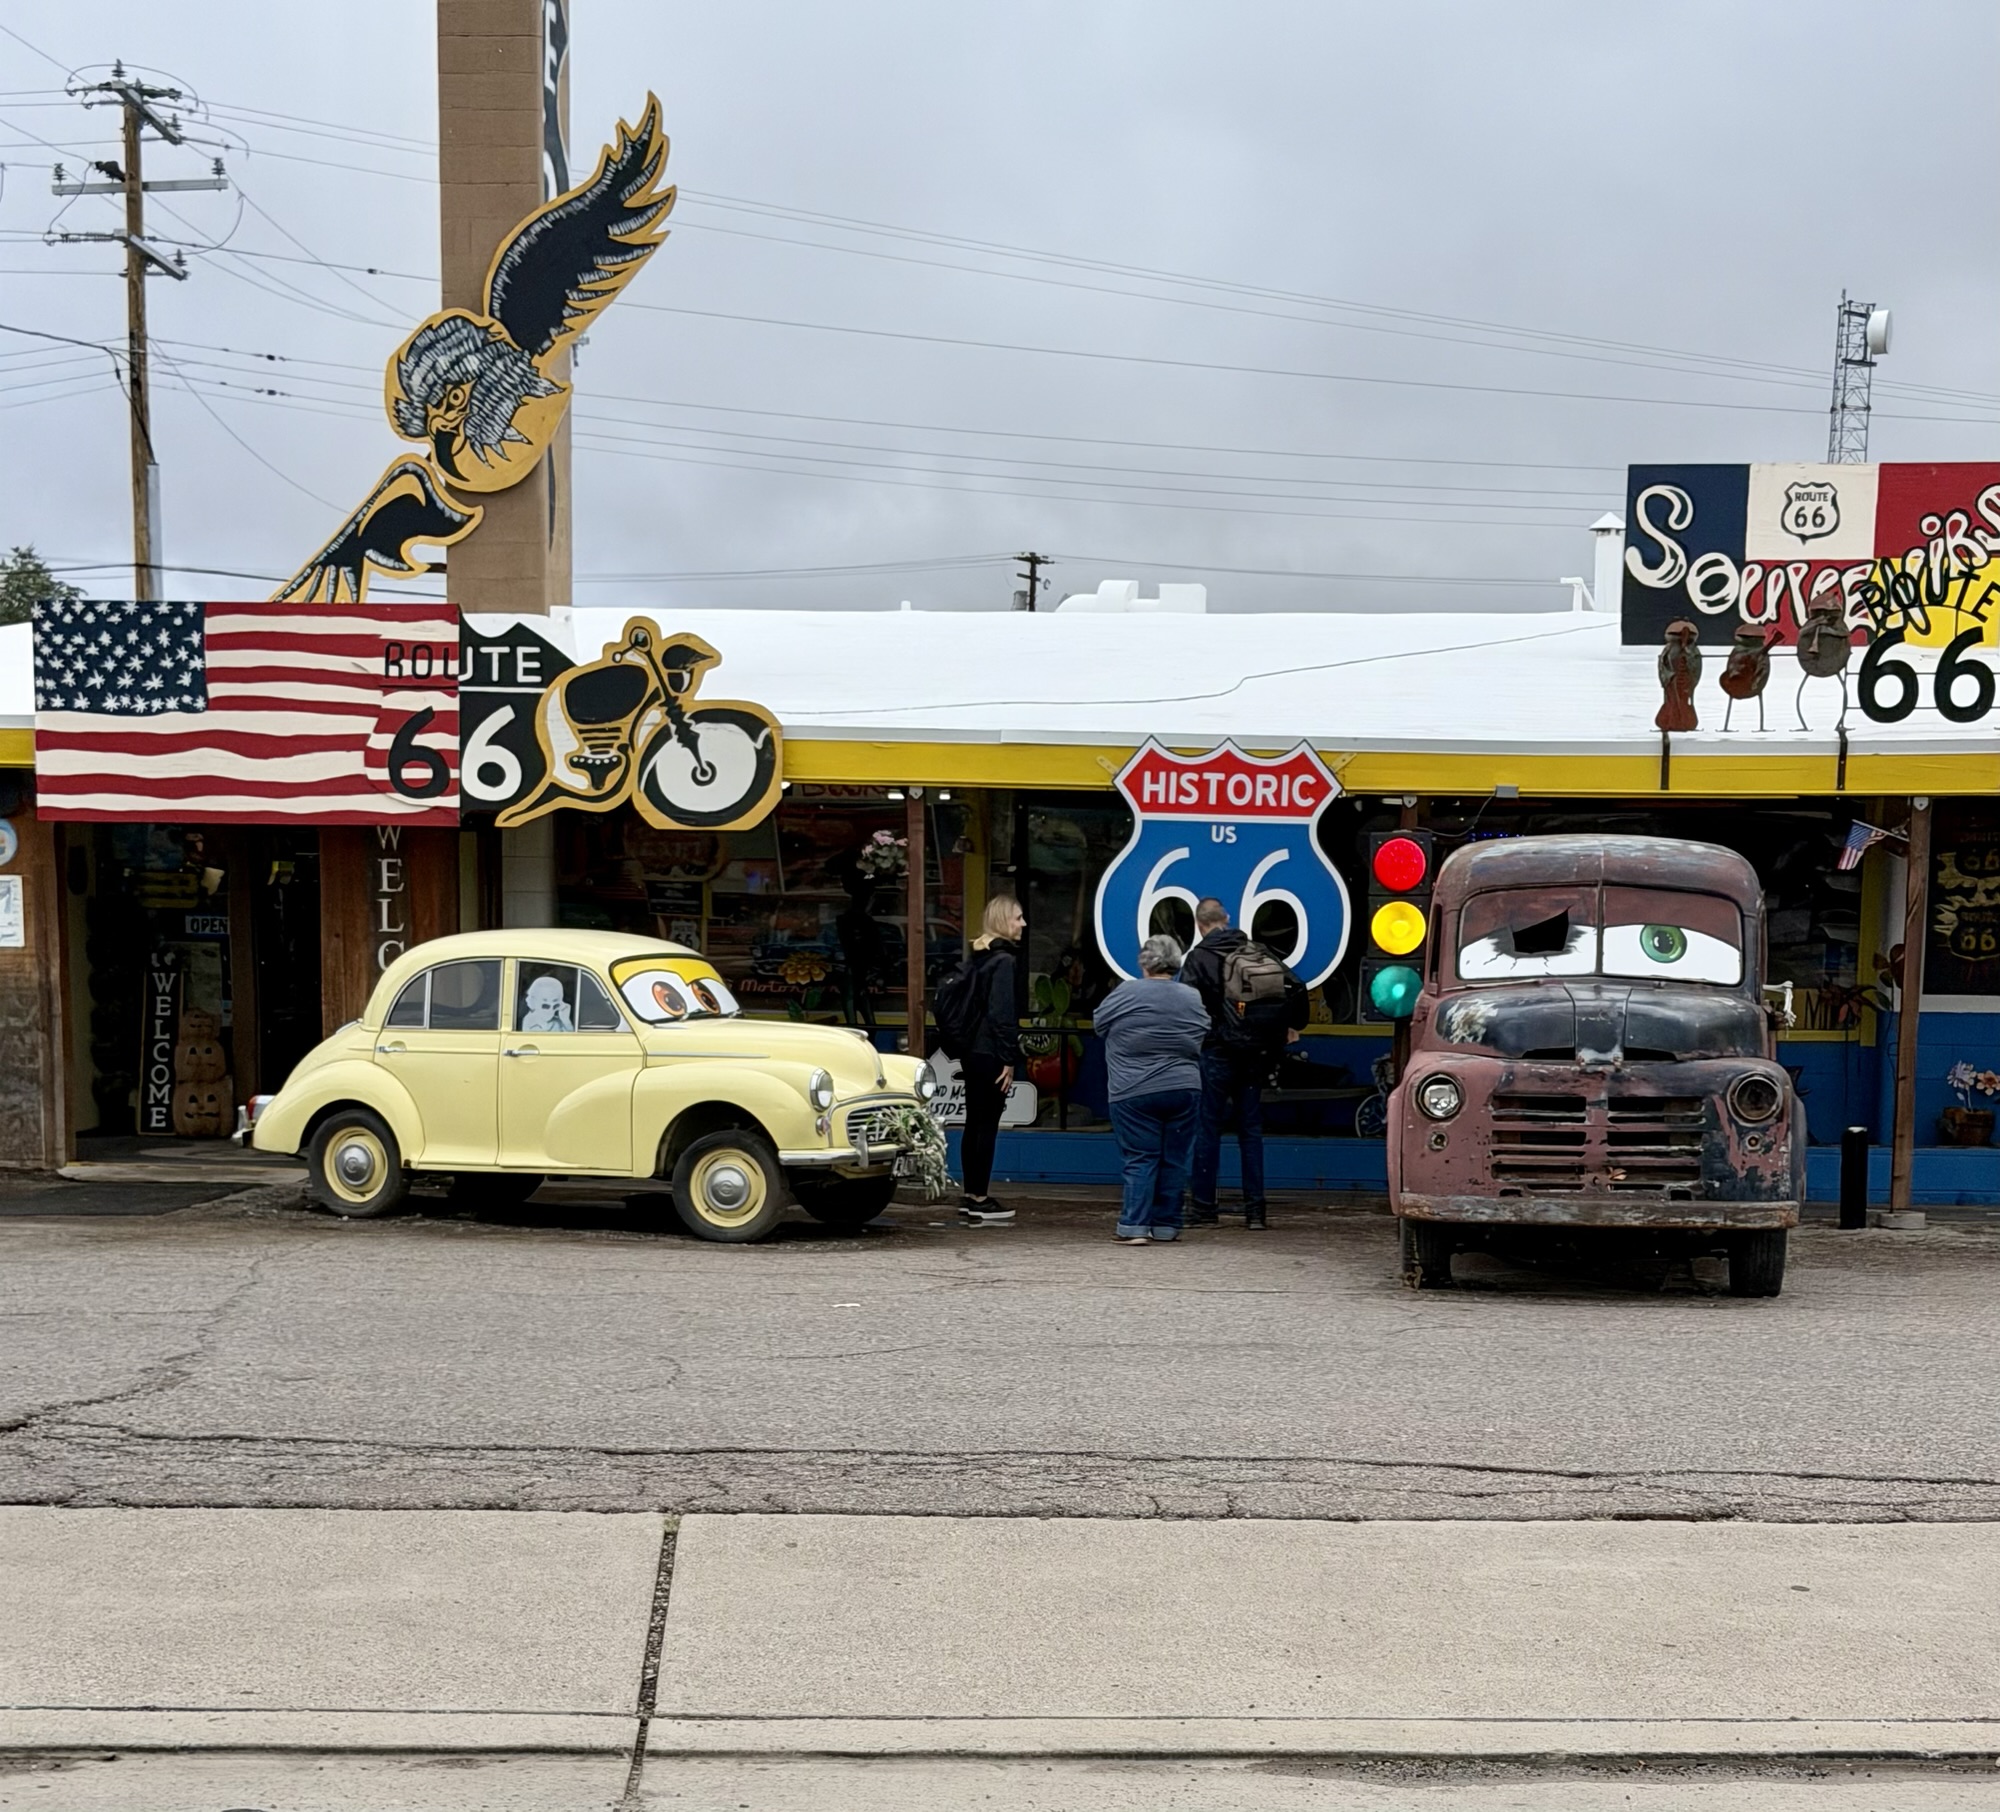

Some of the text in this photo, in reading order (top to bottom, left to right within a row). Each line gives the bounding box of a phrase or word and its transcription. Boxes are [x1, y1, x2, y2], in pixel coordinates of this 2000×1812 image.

[1794, 491, 1829, 502] ROUTE
[1794, 505, 1826, 528] 66
[385, 642, 542, 683] ROUTE
[1858, 627, 1996, 723] 66
[388, 704, 522, 802] 66
[1142, 770, 1318, 808] HISTORIC
[1211, 825, 1237, 844] US
[376, 825, 405, 971] WELC
[1137, 846, 1308, 969] 66
[190, 918, 228, 932] OPEN
[147, 972, 177, 1128] WELCOME
[930, 1103, 967, 1115] SIDE
